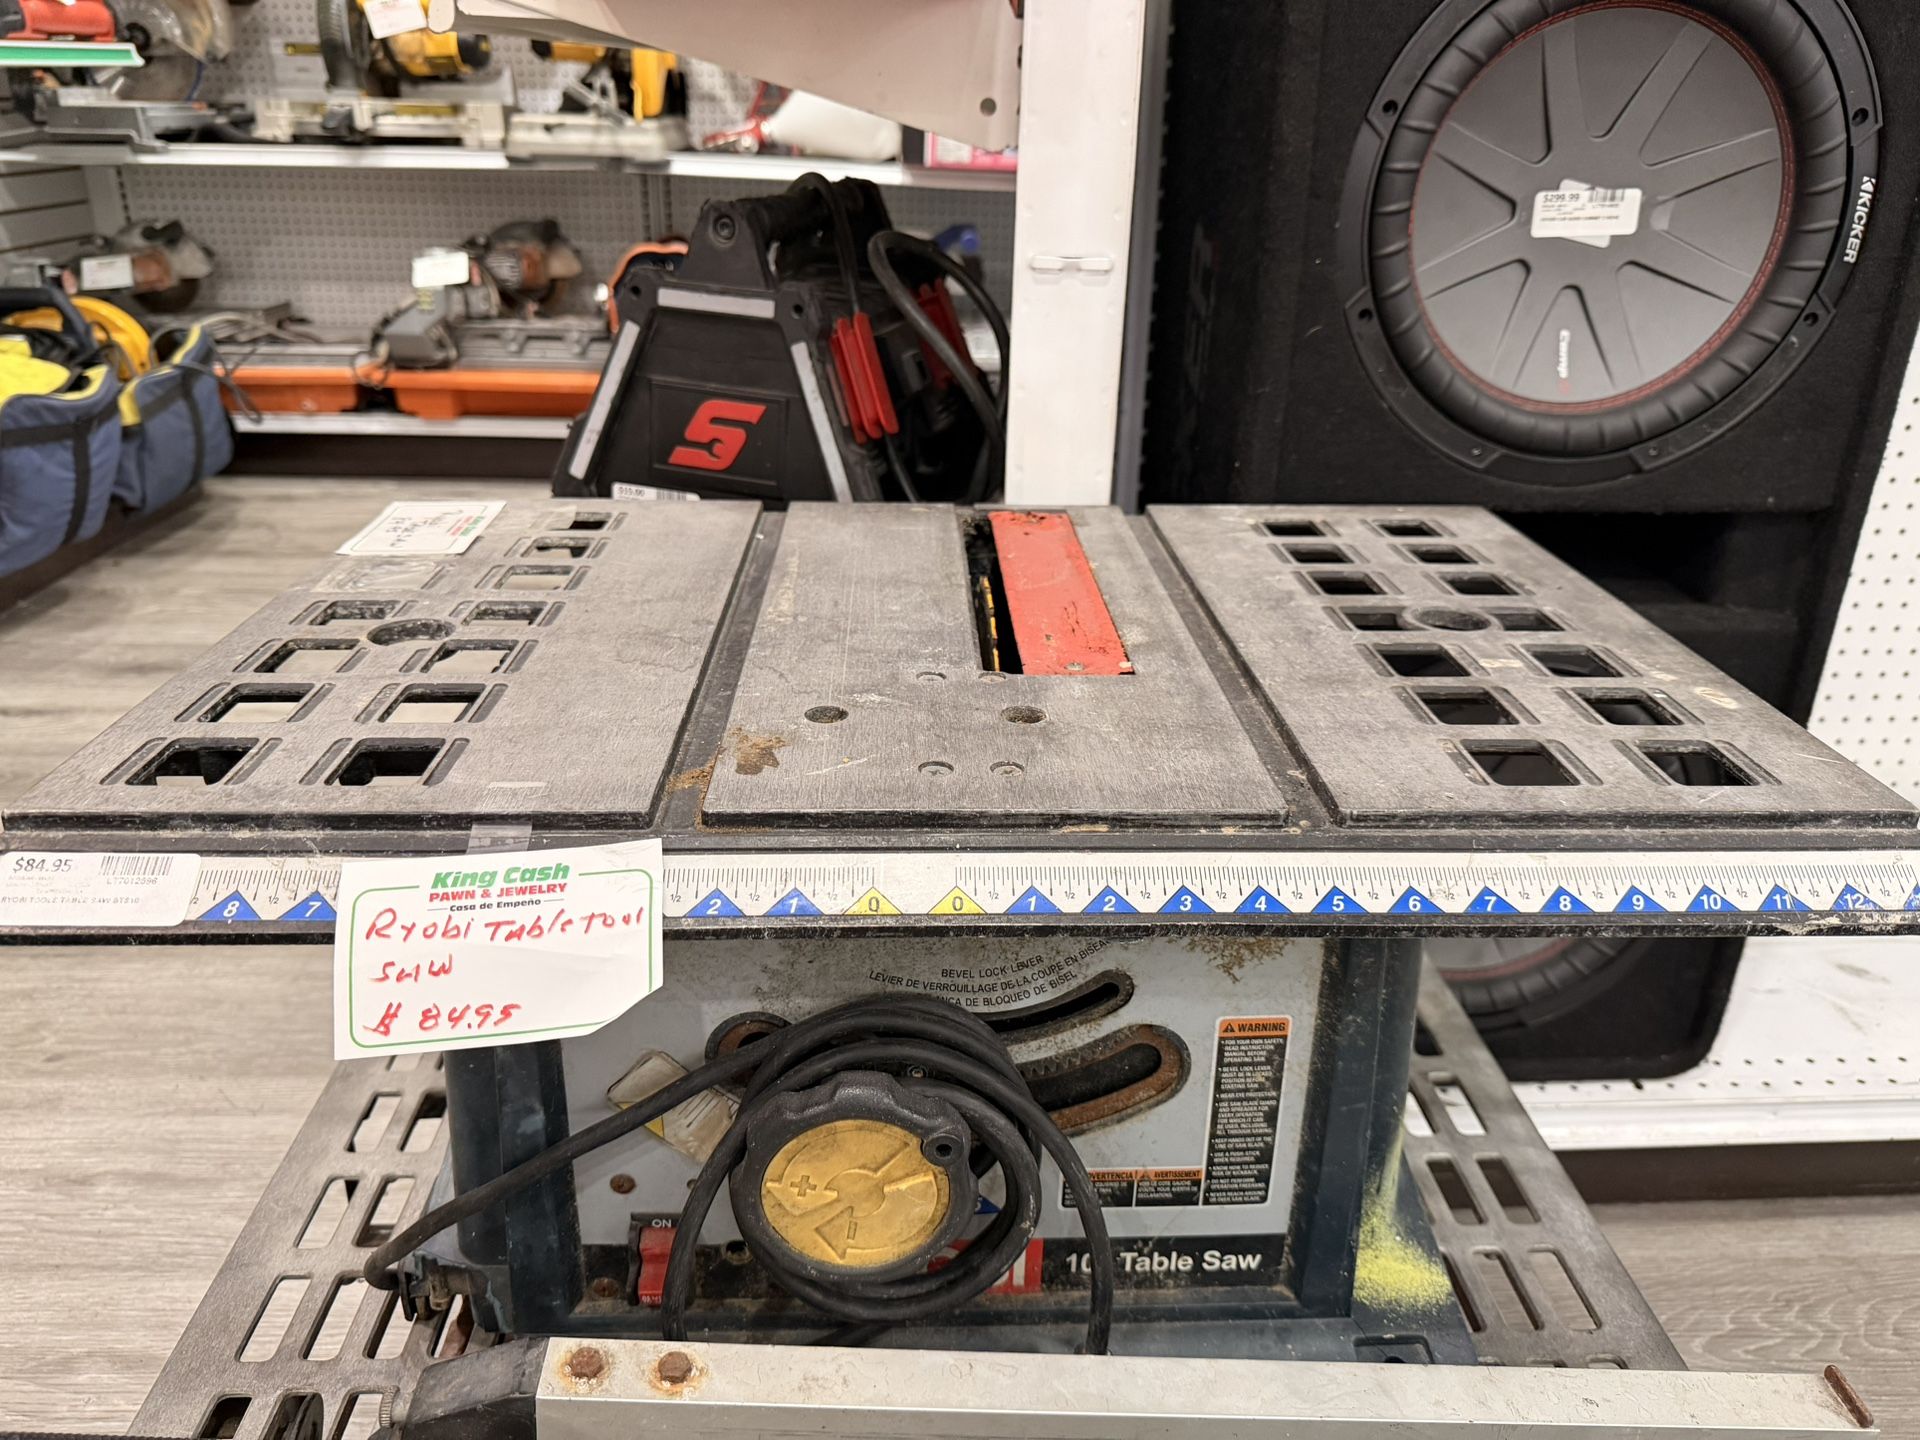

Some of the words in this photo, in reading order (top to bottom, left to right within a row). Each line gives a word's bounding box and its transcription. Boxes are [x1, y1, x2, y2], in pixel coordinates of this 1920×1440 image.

[1843, 175, 1876, 264] KICKER
[13, 857, 73, 873] $84.95
[431, 871, 498, 889] King
[503, 863, 570, 883] Cash
[429, 890, 475, 902] PAWN
[481, 889, 491, 898] &
[497, 883, 567, 897] JEWELRY
[223, 901, 240, 917] 8
[305, 901, 321, 917] 7
[480, 902, 493, 910] de
[497, 899, 541, 908] Empeño
[707, 899, 721, 915] 2
[788, 899, 798, 914] 1
[868, 896, 880, 912] 0
[952, 896, 964, 911] 0
[1027, 896, 1036, 911] 1
[1103, 896, 1116, 910] 2
[1180, 895, 1192, 910] 3
[1255, 895, 1267, 910] 4
[1332, 895, 1344, 910] 5
[1408, 895, 1421, 910] 6
[1484, 896, 1496, 911] 7
[1559, 895, 1572, 910] 8
[1632, 894, 1644, 909] 9
[1700, 894, 1721, 909] 10
[1773, 894, 1790, 909] 11
[1845, 894, 1864, 908] 12
[366, 908, 475, 942] Ryobi
[869, 970, 903, 985] LEVIER
[906, 979, 919, 988] DE
[923, 981, 998, 993] VERROUILLAGE
[1001, 981, 1015, 991] DE
[1017, 976, 1030, 987] LA
[1032, 962, 1064, 981] COUPE
[1065, 955, 1078, 966] EN
[1079, 940, 1110, 959] BISEA
[942, 969, 975, 978] BEVEL
[979, 965, 1008, 978] LOCK
[1011, 955, 1044, 973] LEVER
[966, 998, 978, 1006] DE
[984, 990, 1030, 1006] BLOQUEO
[1034, 984, 1047, 995] DE
[1049, 971, 1077, 989] BISEL
[418, 1003, 522, 1031] 84.95
[1238, 1022, 1285, 1032] WARNING
[1089, 1170, 1133, 1180] VERTENCIA
[1154, 1170, 1200, 1178] AVERTISSEMENT
[651, 1219, 672, 1228] ON
[1120, 1251, 1193, 1272] Table
[1201, 1249, 1262, 1270] Saw
